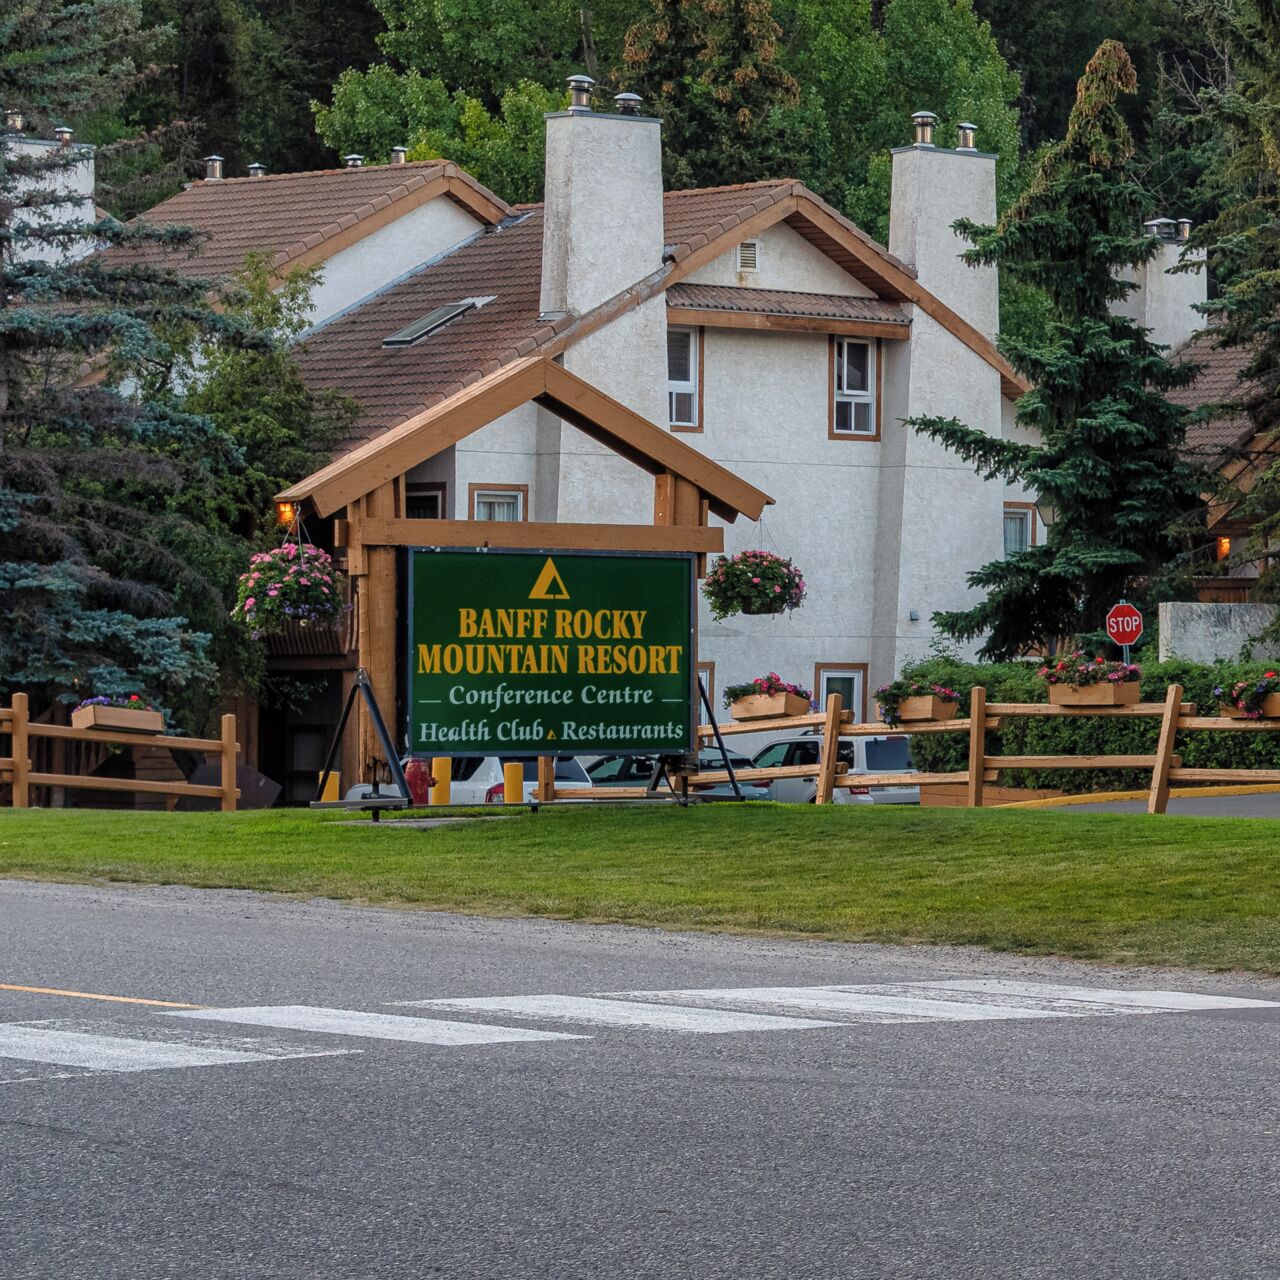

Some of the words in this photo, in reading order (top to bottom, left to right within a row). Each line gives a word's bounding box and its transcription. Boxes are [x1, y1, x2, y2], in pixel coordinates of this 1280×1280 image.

[458, 608, 548, 638] BANFF
[554, 609, 647, 639] ROCKY
[1109, 616, 1140, 633] STOP
[417, 643, 569, 674] MOUNTAIN
[577, 645, 683, 674] RESORT
[449, 682, 574, 713] Conference
[581, 685, 654, 704] Centre
[419, 719, 492, 742] Health
[496, 718, 544, 741] Club
[560, 721, 684, 740] Restaurants
